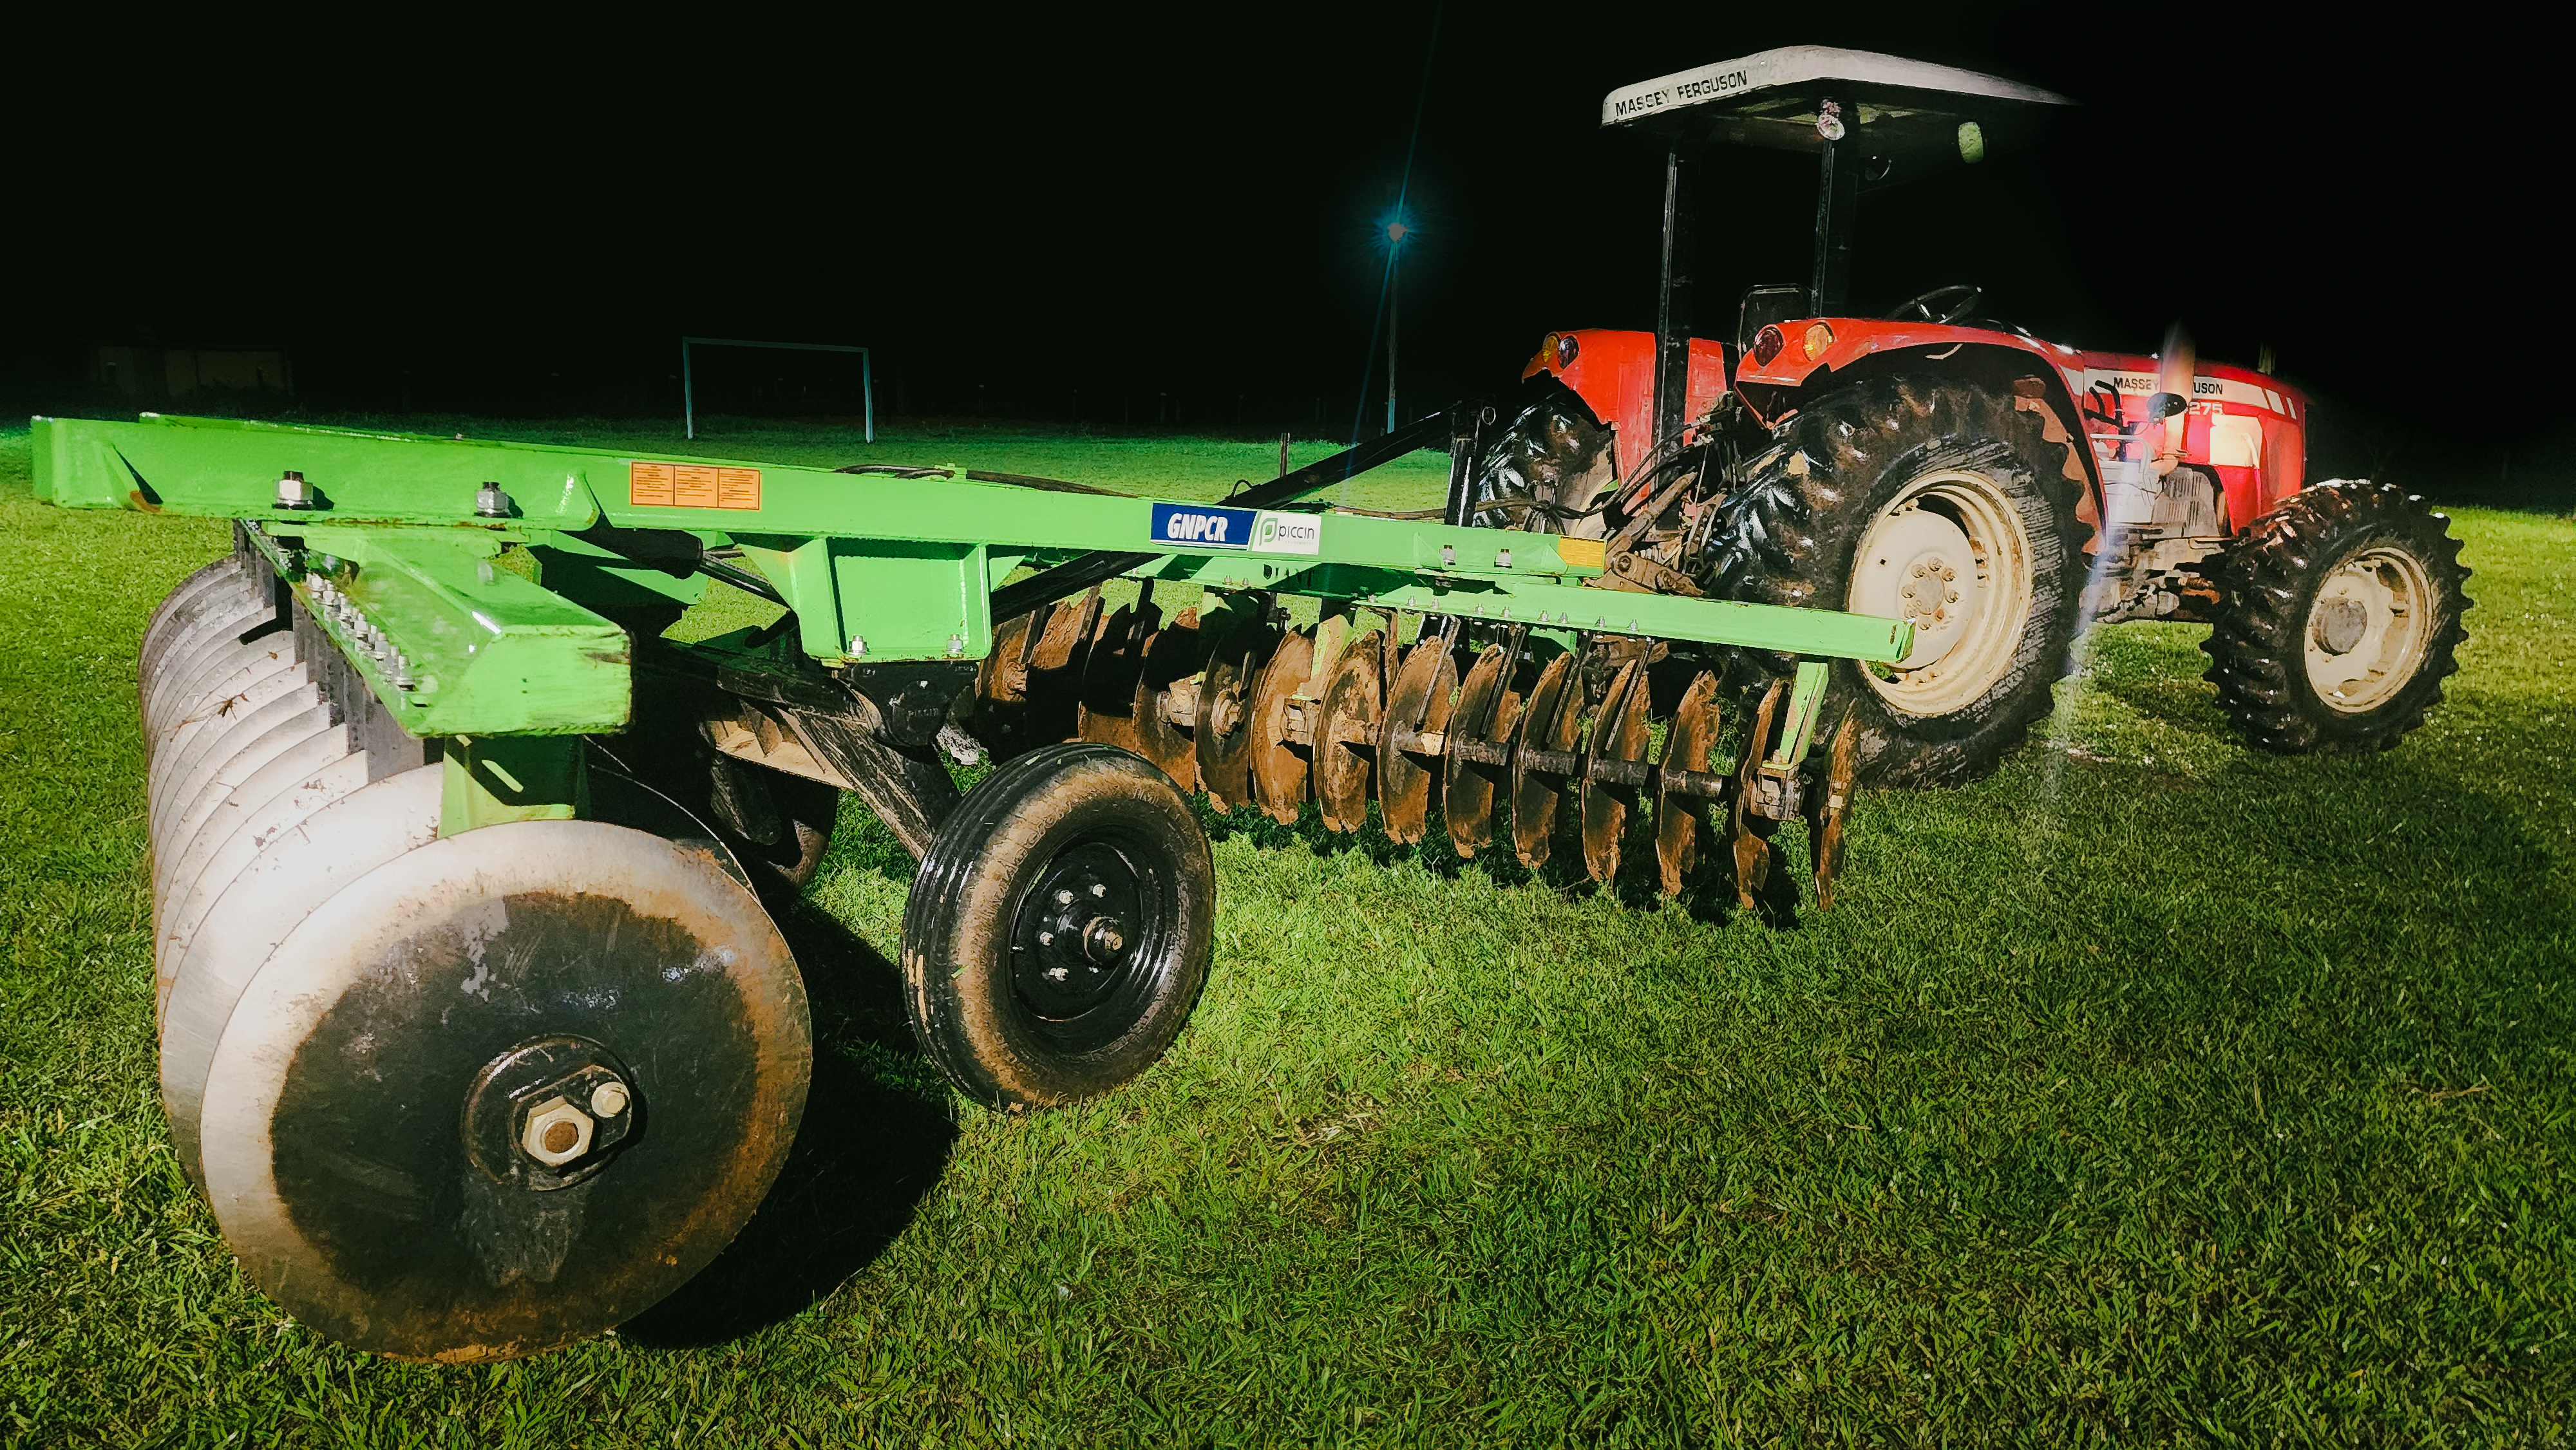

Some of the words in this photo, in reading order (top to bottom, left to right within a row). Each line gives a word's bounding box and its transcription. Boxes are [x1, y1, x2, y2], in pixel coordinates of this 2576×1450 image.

[1615, 88, 1670, 117] MASSEY
[1676, 70, 1748, 100] FERGUSON
[2114, 377, 2159, 391] MASSEY
[2189, 401, 2223, 415] 275
[1167, 513, 1228, 541] GNPCR
[1278, 525, 1314, 541] piccin
